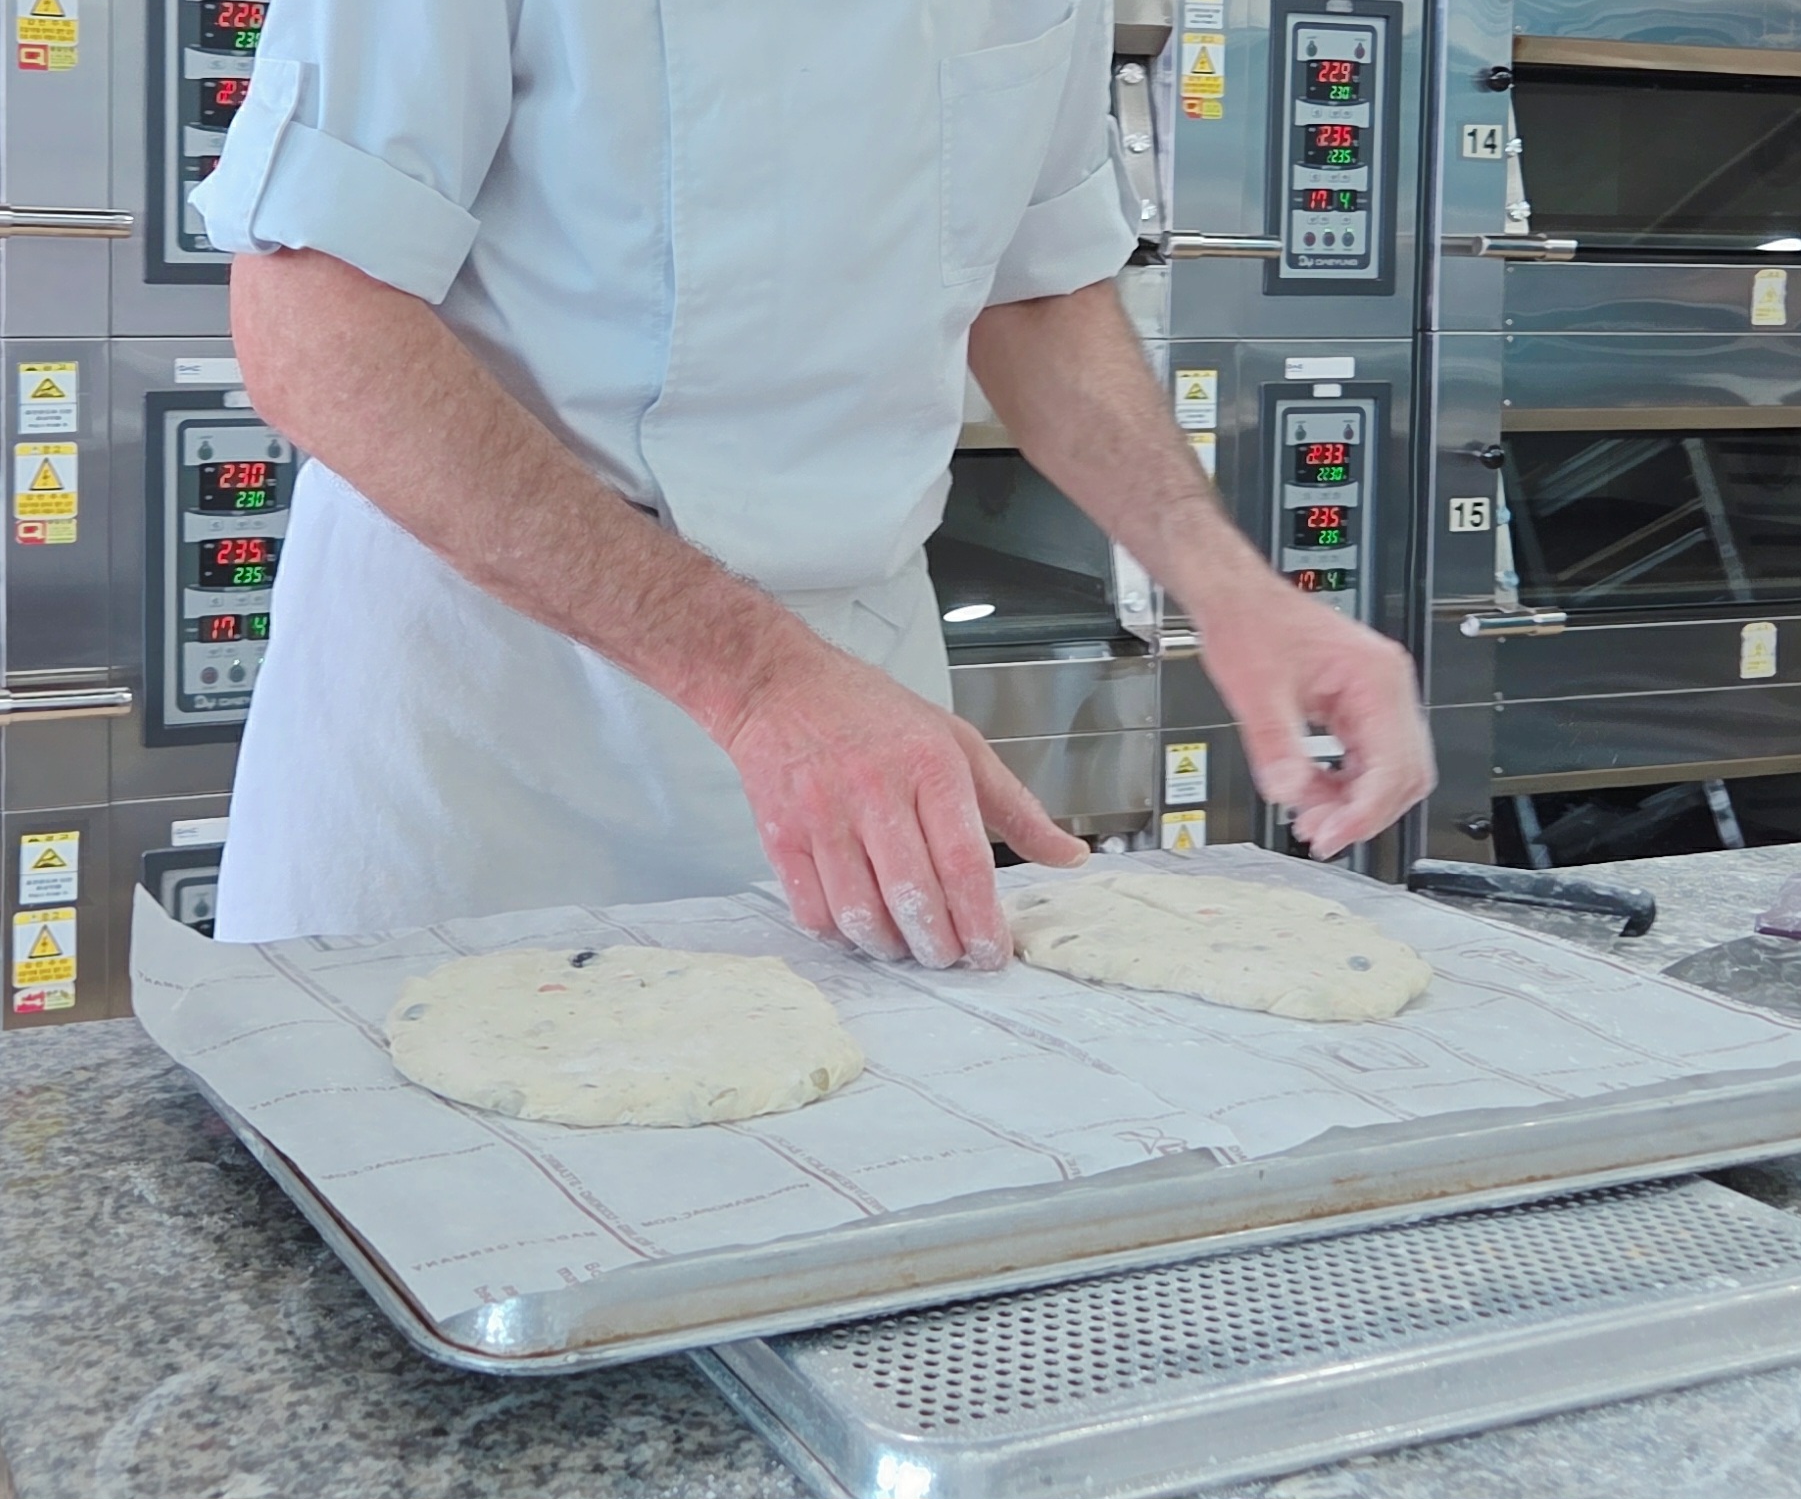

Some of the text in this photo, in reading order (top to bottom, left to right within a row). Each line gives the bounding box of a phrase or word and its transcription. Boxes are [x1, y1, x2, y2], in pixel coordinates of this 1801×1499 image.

[218, 2, 265, 28] 228
[1318, 61, 1351, 82] 229
[1329, 85, 1351, 99] 230
[1317, 125, 1352, 146] 235
[1467, 128, 1498, 154] 14
[1310, 190, 1328, 209] 17
[1340, 192, 1351, 209] 4
[219, 463, 266, 488] 230
[235, 491, 266, 508] 230
[1307, 507, 1340, 527] 235
[1454, 502, 1485, 527] 15
[1318, 530, 1340, 544] 235
[217, 540, 263, 564] 235
[233, 566, 263, 583] 235
[1298, 571, 1315, 590] 17
[1327, 571, 1338, 589] 4
[211, 616, 235, 639] 17
[254, 616, 268, 637] 4
